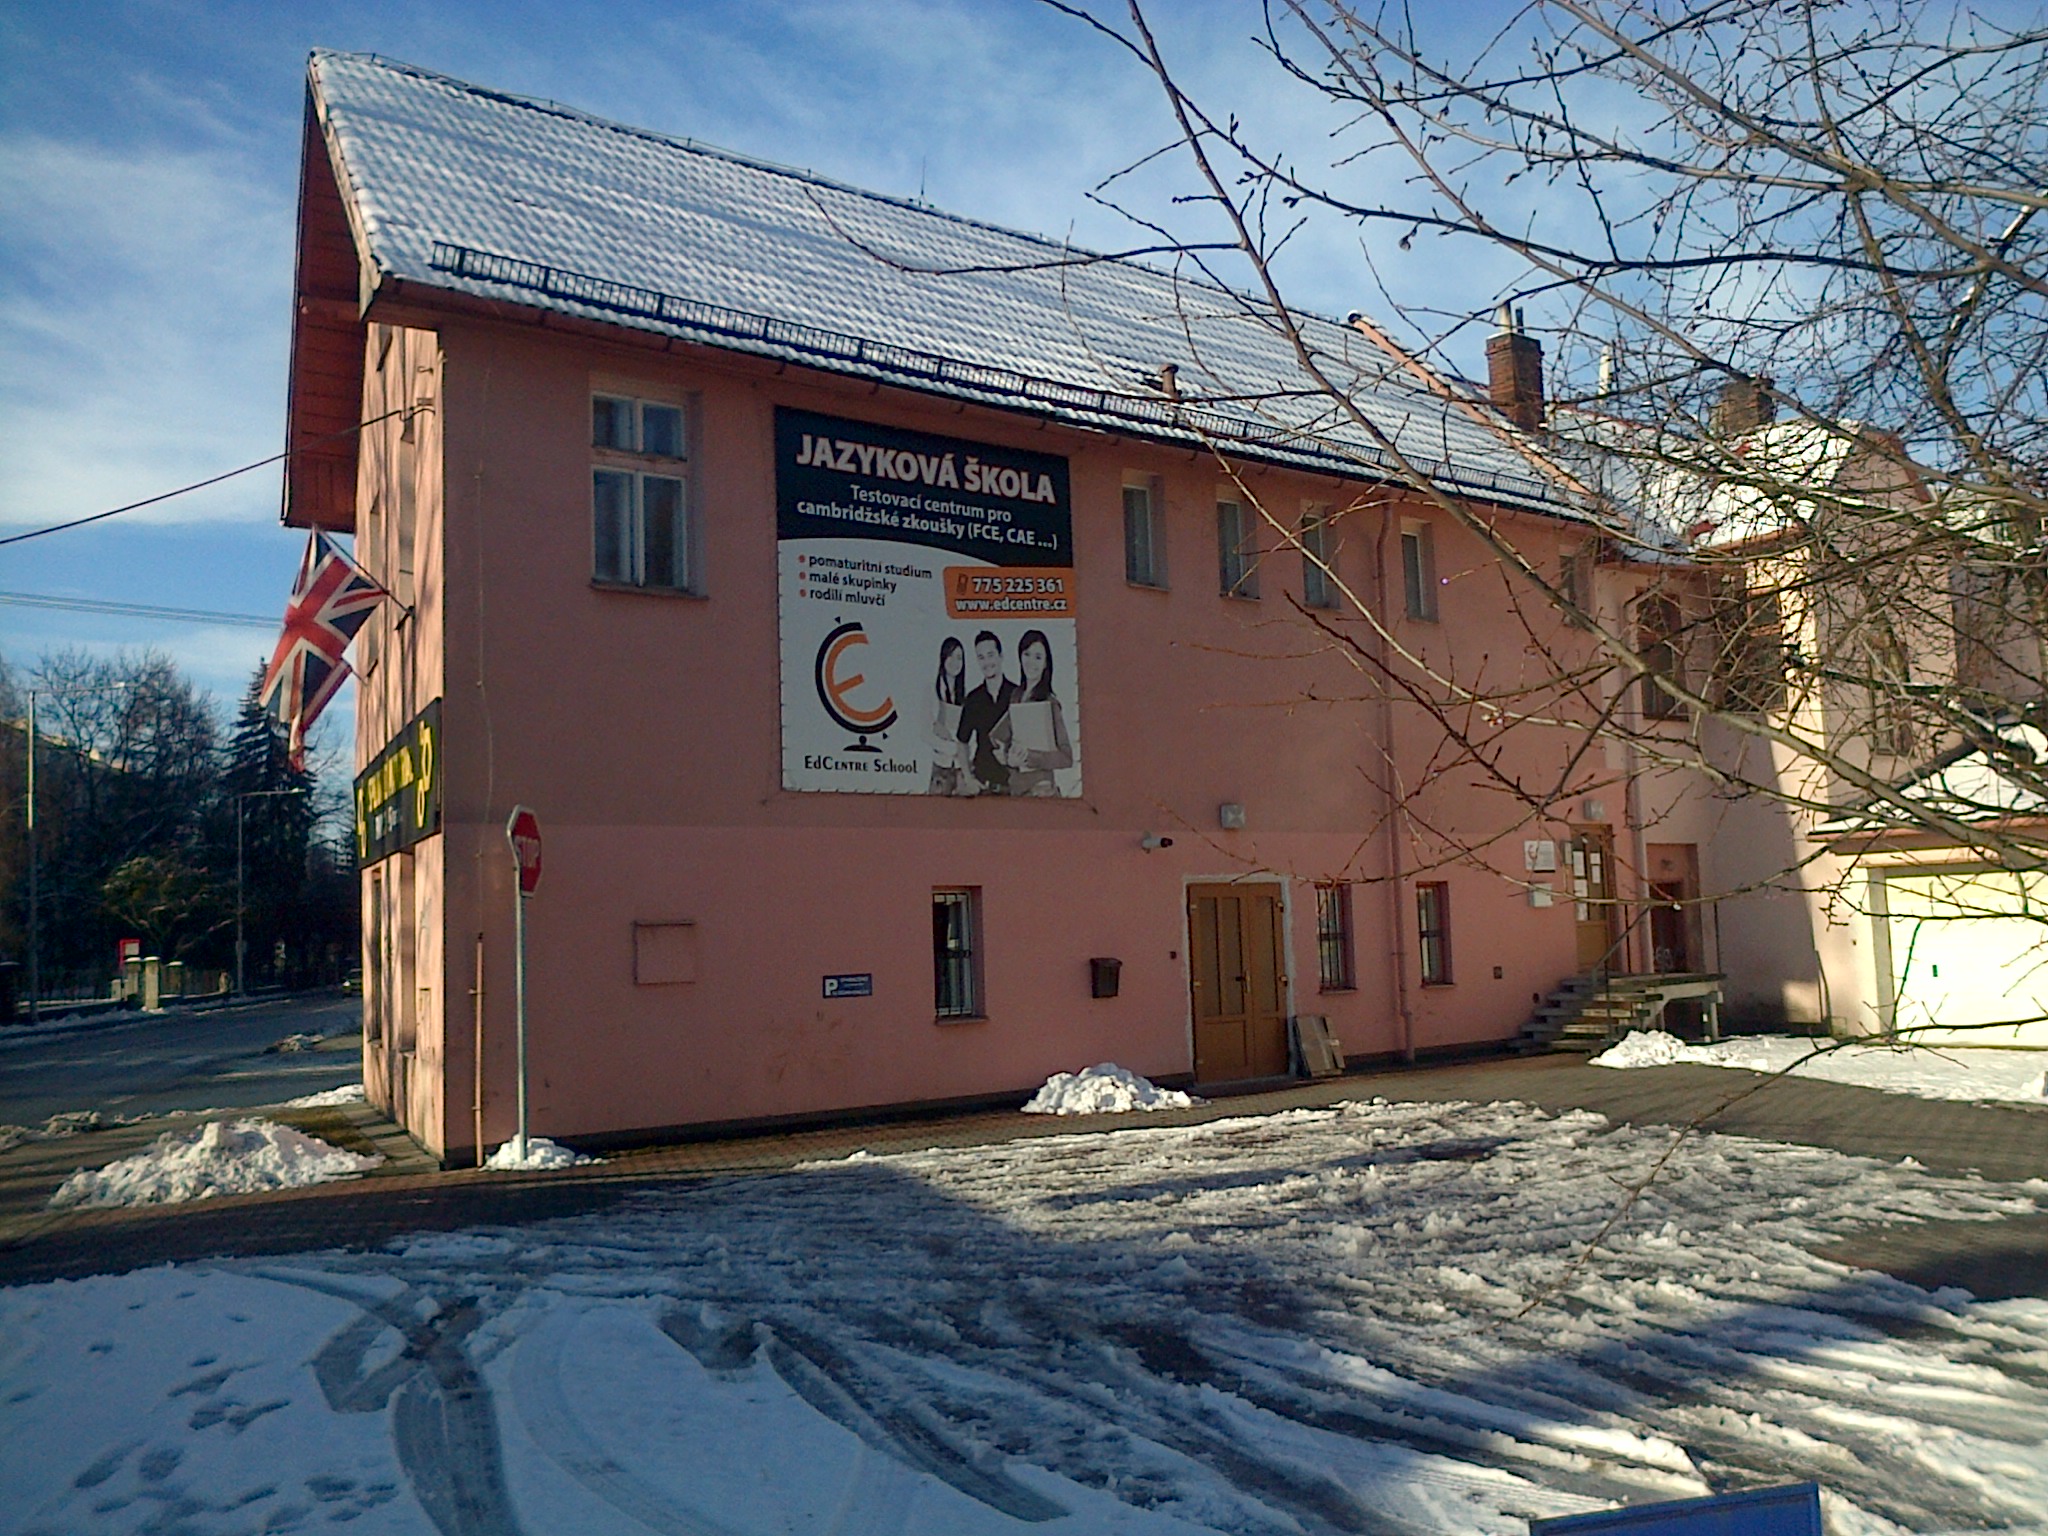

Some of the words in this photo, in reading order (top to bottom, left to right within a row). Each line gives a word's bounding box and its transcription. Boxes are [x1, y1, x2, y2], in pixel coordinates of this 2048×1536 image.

[796, 433, 960, 489] JAZYKOVÁ
[963, 455, 1056, 504] ŠKOLA
[850, 484, 922, 509] Testovací
[924, 499, 985, 519] centrum
[988, 509, 1012, 523] pro
[796, 501, 900, 527] cambridžské
[902, 514, 965, 539] zkoušky
[968, 522, 1004, 543] (FCE,
[1006, 528, 1035, 545] CAE
[809, 555, 882, 573] pomaturitní
[885, 564, 932, 579] studium
[809, 571, 840, 584] malé
[842, 573, 897, 594] skupinky
[972, 577, 1002, 593] 775
[1005, 577, 1034, 593] 225
[1037, 578, 1064, 593] 361
[810, 587, 842, 601] rodilí
[845, 591, 885, 606] mluvčí
[955, 596, 1067, 611] www.edcentre.cz
[873, 758, 919, 774] School
[825, 978, 838, 996] P
